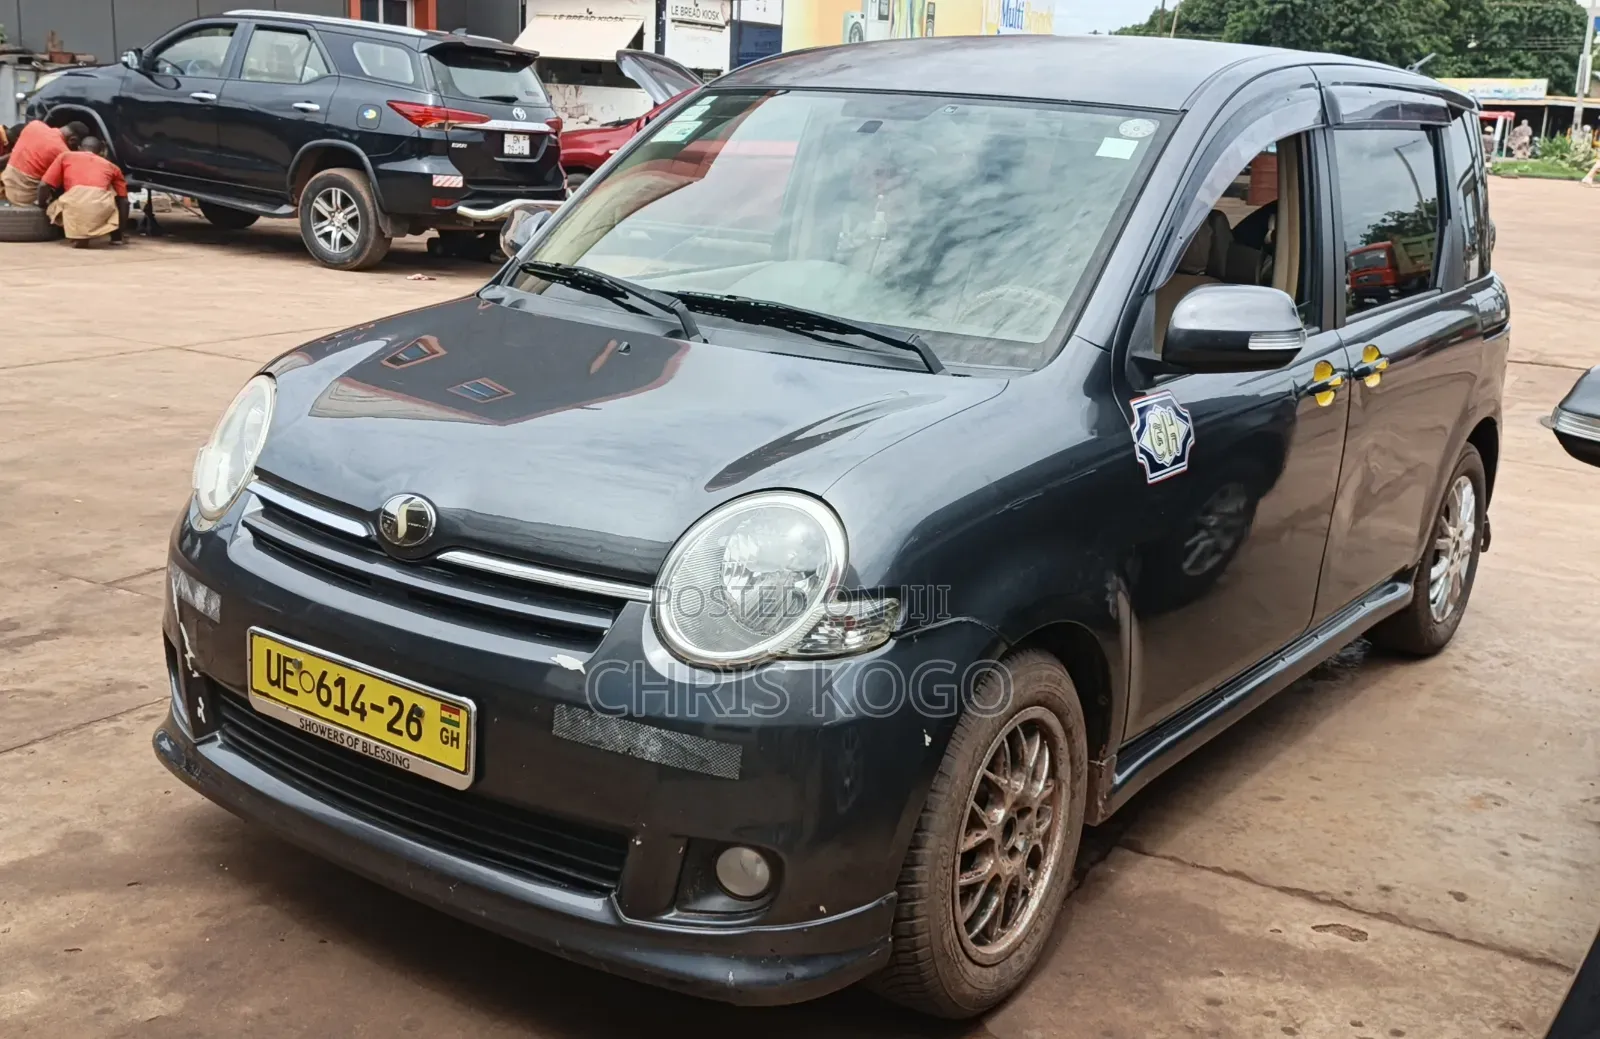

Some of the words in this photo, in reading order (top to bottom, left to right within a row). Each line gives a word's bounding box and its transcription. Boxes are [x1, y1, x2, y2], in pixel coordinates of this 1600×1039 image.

[671, 5, 679, 15] LE
[680, 6, 702, 19] BREAD
[702, 9, 720, 21] KIOSK
[1002, 0, 1024, 30] Multi
[265, 648, 299, 697] UE
[315, 670, 425, 743] 614-26
[299, 717, 345, 744] SHOWERS
[346, 735, 360, 751] OF
[361, 740, 411, 770] BLESSING
[439, 727, 460, 750] GH
